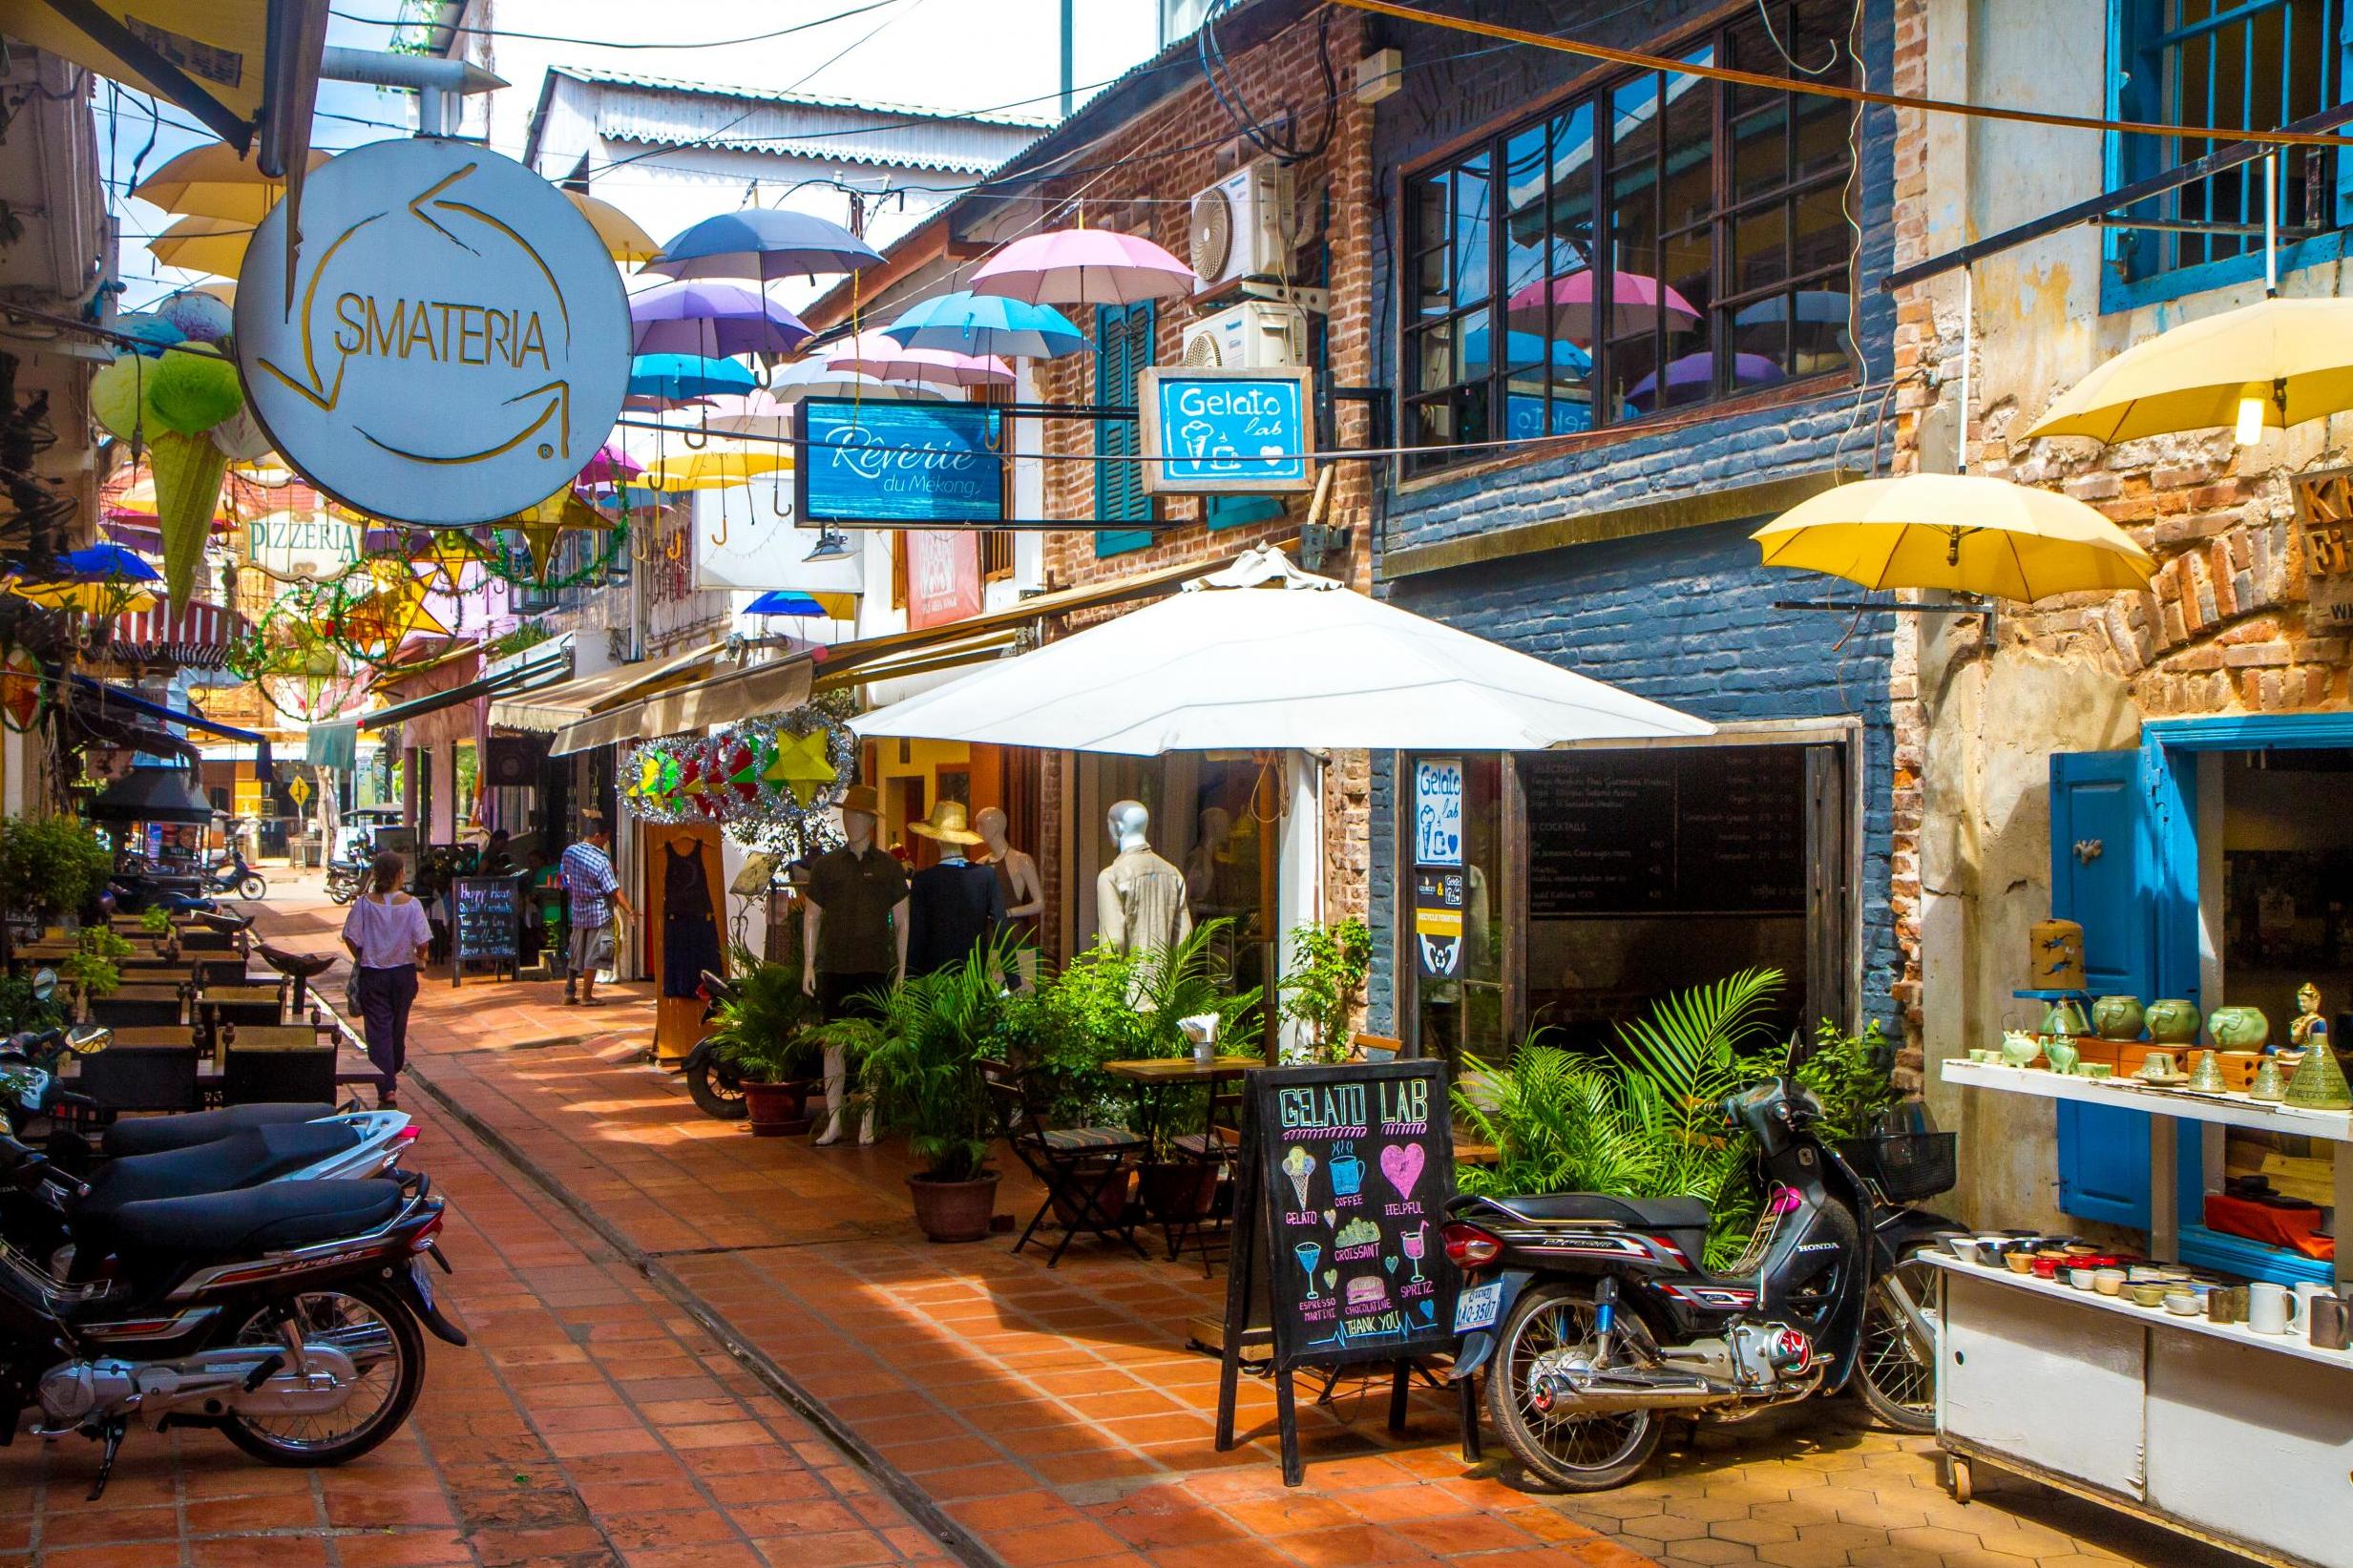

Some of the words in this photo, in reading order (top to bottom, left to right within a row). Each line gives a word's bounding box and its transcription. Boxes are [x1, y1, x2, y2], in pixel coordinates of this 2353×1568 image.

[335, 292, 550, 371] SMATERIA
[1180, 387, 1281, 417] Gelato
[1243, 417, 1282, 436] lab
[883, 473, 905, 492] du
[249, 521, 358, 563] PIZZERIA
[1420, 765, 1461, 796] Gelato
[1442, 798, 1459, 819] lab
[1279, 1084, 1367, 1128] GELATO
[1379, 1079, 1428, 1124] LAB
[1334, 1194, 1364, 1207] COFFEE
[1385, 1202, 1424, 1216] HELPFUL
[1286, 1211, 1317, 1224] GELATO
[1334, 1243, 1381, 1262] CROISSANT
[1797, 1242, 1840, 1252] HONDA
[1400, 1281, 1434, 1299] SPRITZ
[1299, 1298, 1336, 1310] ESPRESSO
[1345, 1298, 1392, 1315] CHOCOLATINE
[1304, 1307, 1336, 1322] MARTINI
[1345, 1317, 1376, 1335] THANK
[1377, 1310, 1399, 1331] YOU
